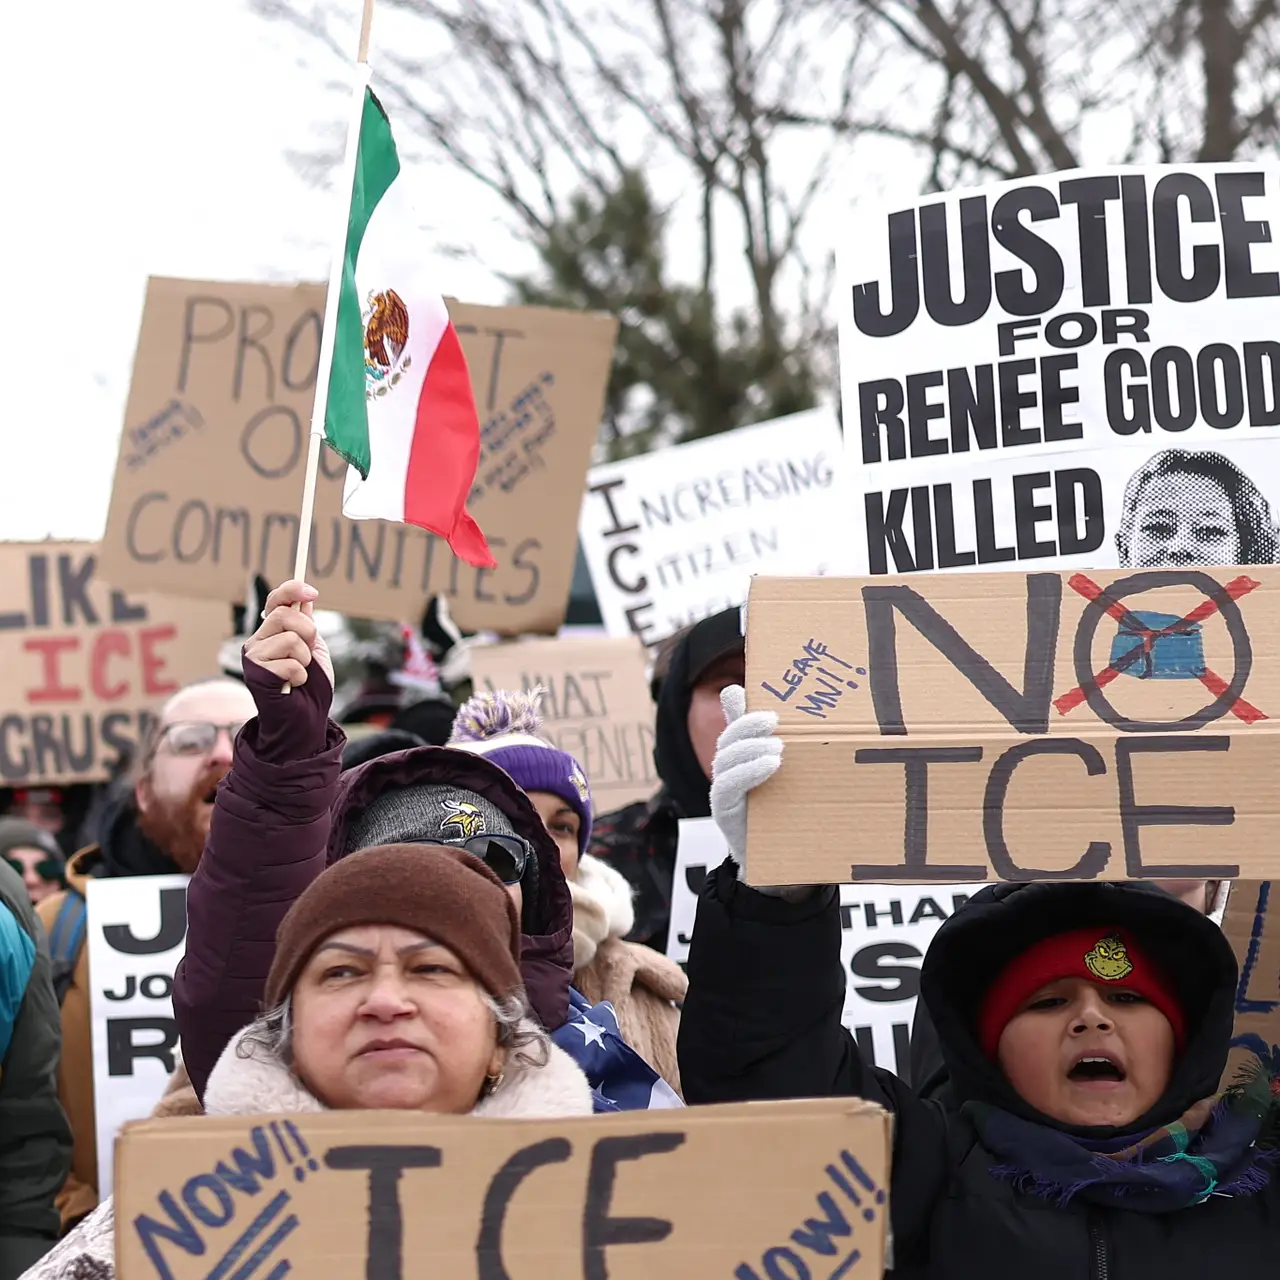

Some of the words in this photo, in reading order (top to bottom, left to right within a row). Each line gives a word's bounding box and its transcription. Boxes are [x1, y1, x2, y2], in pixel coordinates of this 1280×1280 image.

[852, 172, 1280, 337] JUSTICE
[177, 296, 525, 410] PROT
[997, 308, 1152, 356] FOR
[858, 353, 1084, 464] RENEE
[1103, 341, 1280, 435] GOOD
[590, 451, 834, 537] INCREASING
[864, 467, 1104, 575] KILLED
[607, 526, 779, 594] CITIZEN
[24, 624, 180, 704] ICE
[520, 670, 613, 720] HAT
[761, 639, 827, 702] LEAVE
[861, 571, 1252, 735] NO
[851, 735, 1240, 882] ICE
